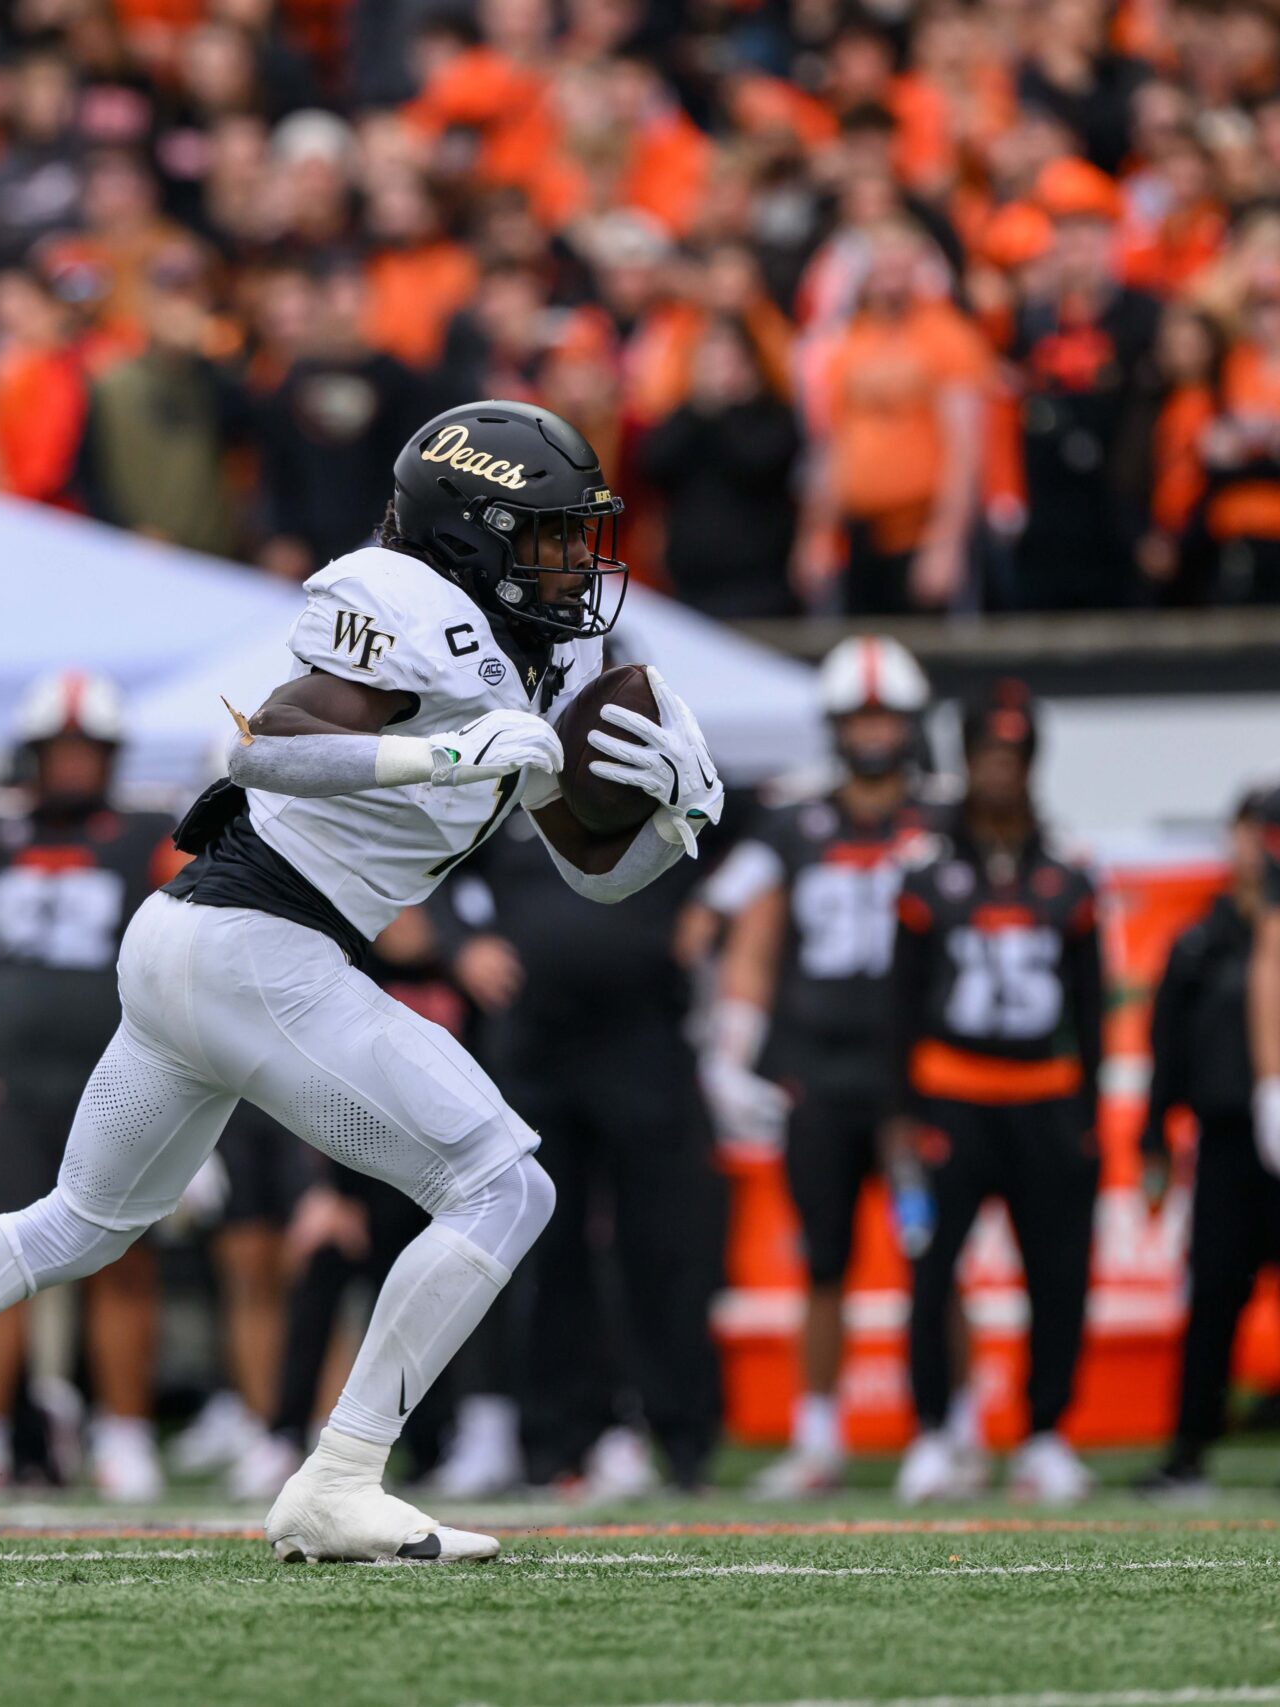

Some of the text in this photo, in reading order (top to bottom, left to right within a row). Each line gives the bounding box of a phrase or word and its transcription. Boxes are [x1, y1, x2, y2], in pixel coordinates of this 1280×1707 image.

[421, 425, 527, 490] Deacs
[331, 608, 396, 674] WF
[445, 623, 479, 657] C
[483, 665, 503, 677] ACC
[948, 926, 1062, 1038] 15
